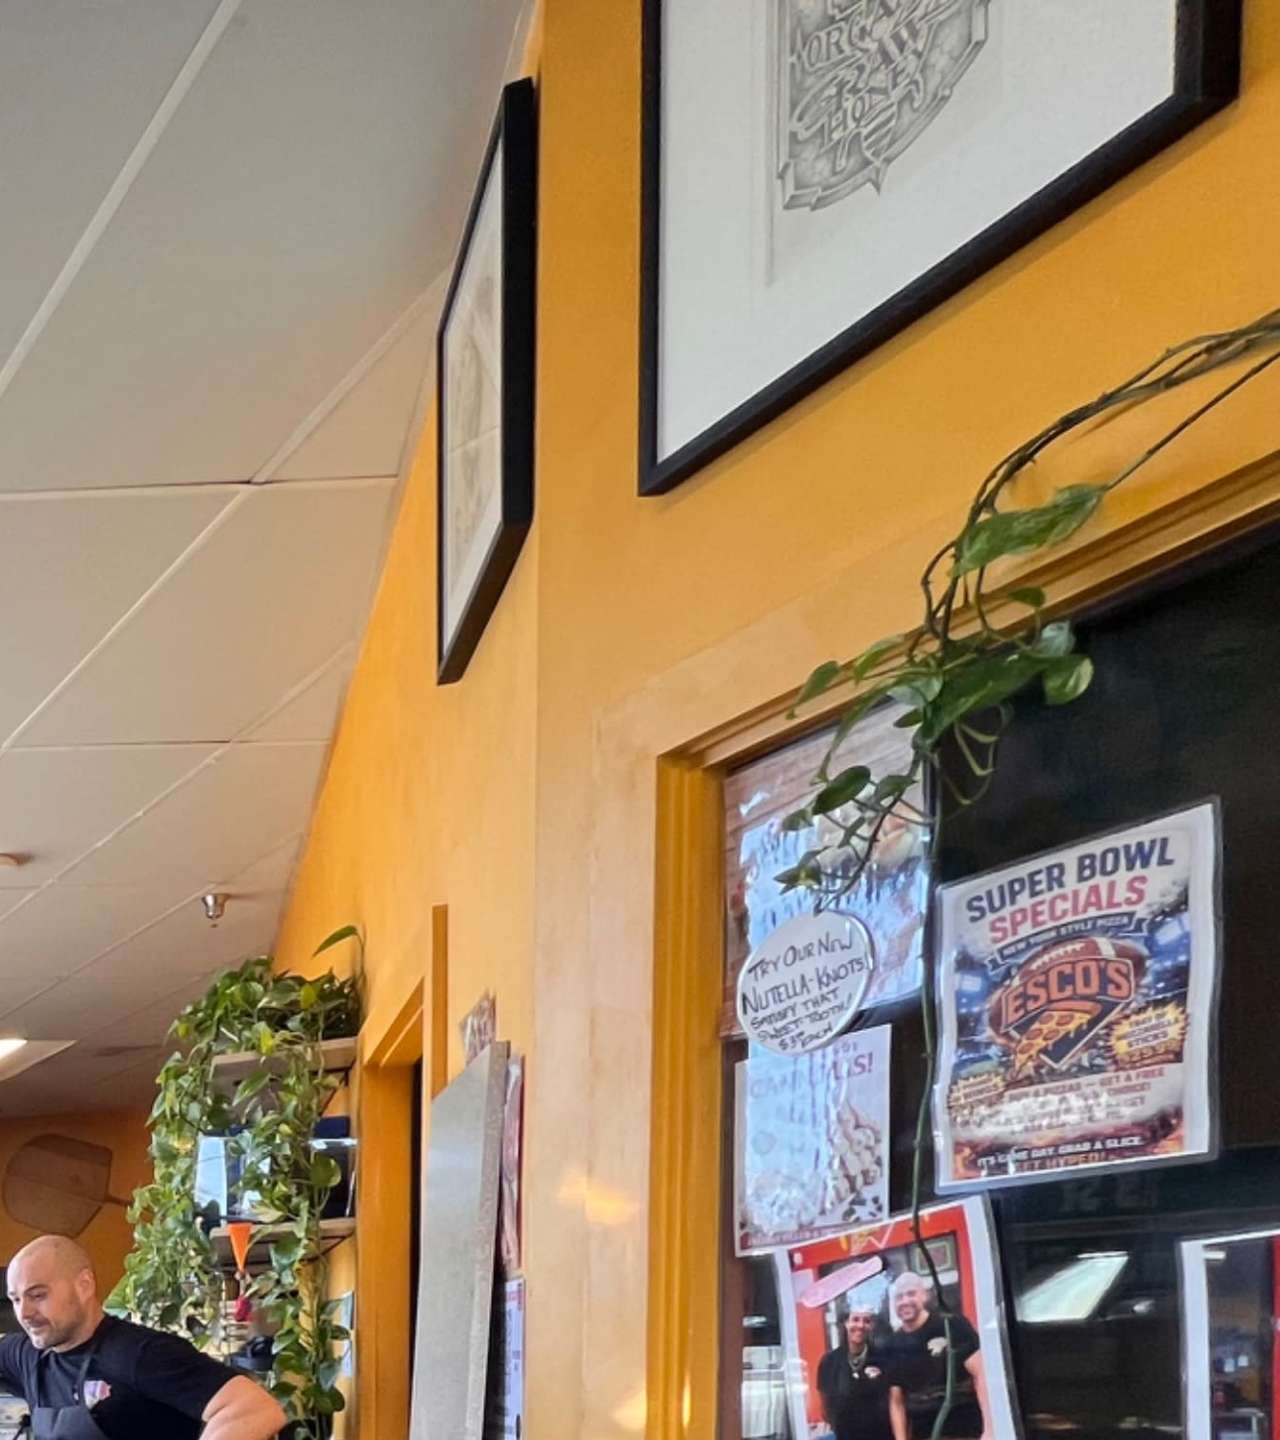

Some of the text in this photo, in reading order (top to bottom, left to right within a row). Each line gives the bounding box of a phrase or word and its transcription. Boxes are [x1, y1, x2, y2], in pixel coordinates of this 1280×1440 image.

[966, 862, 1067, 923] SUPER
[1077, 836, 1175, 884] BOWL
[988, 875, 1149, 944] SPECIALS
[1060, 920, 1094, 936] STYLE
[748, 955, 781, 982] TRY
[783, 943, 815, 967] OUR
[801, 987, 840, 1011] THAT
[1006, 959, 1131, 1022] ESCO'S
